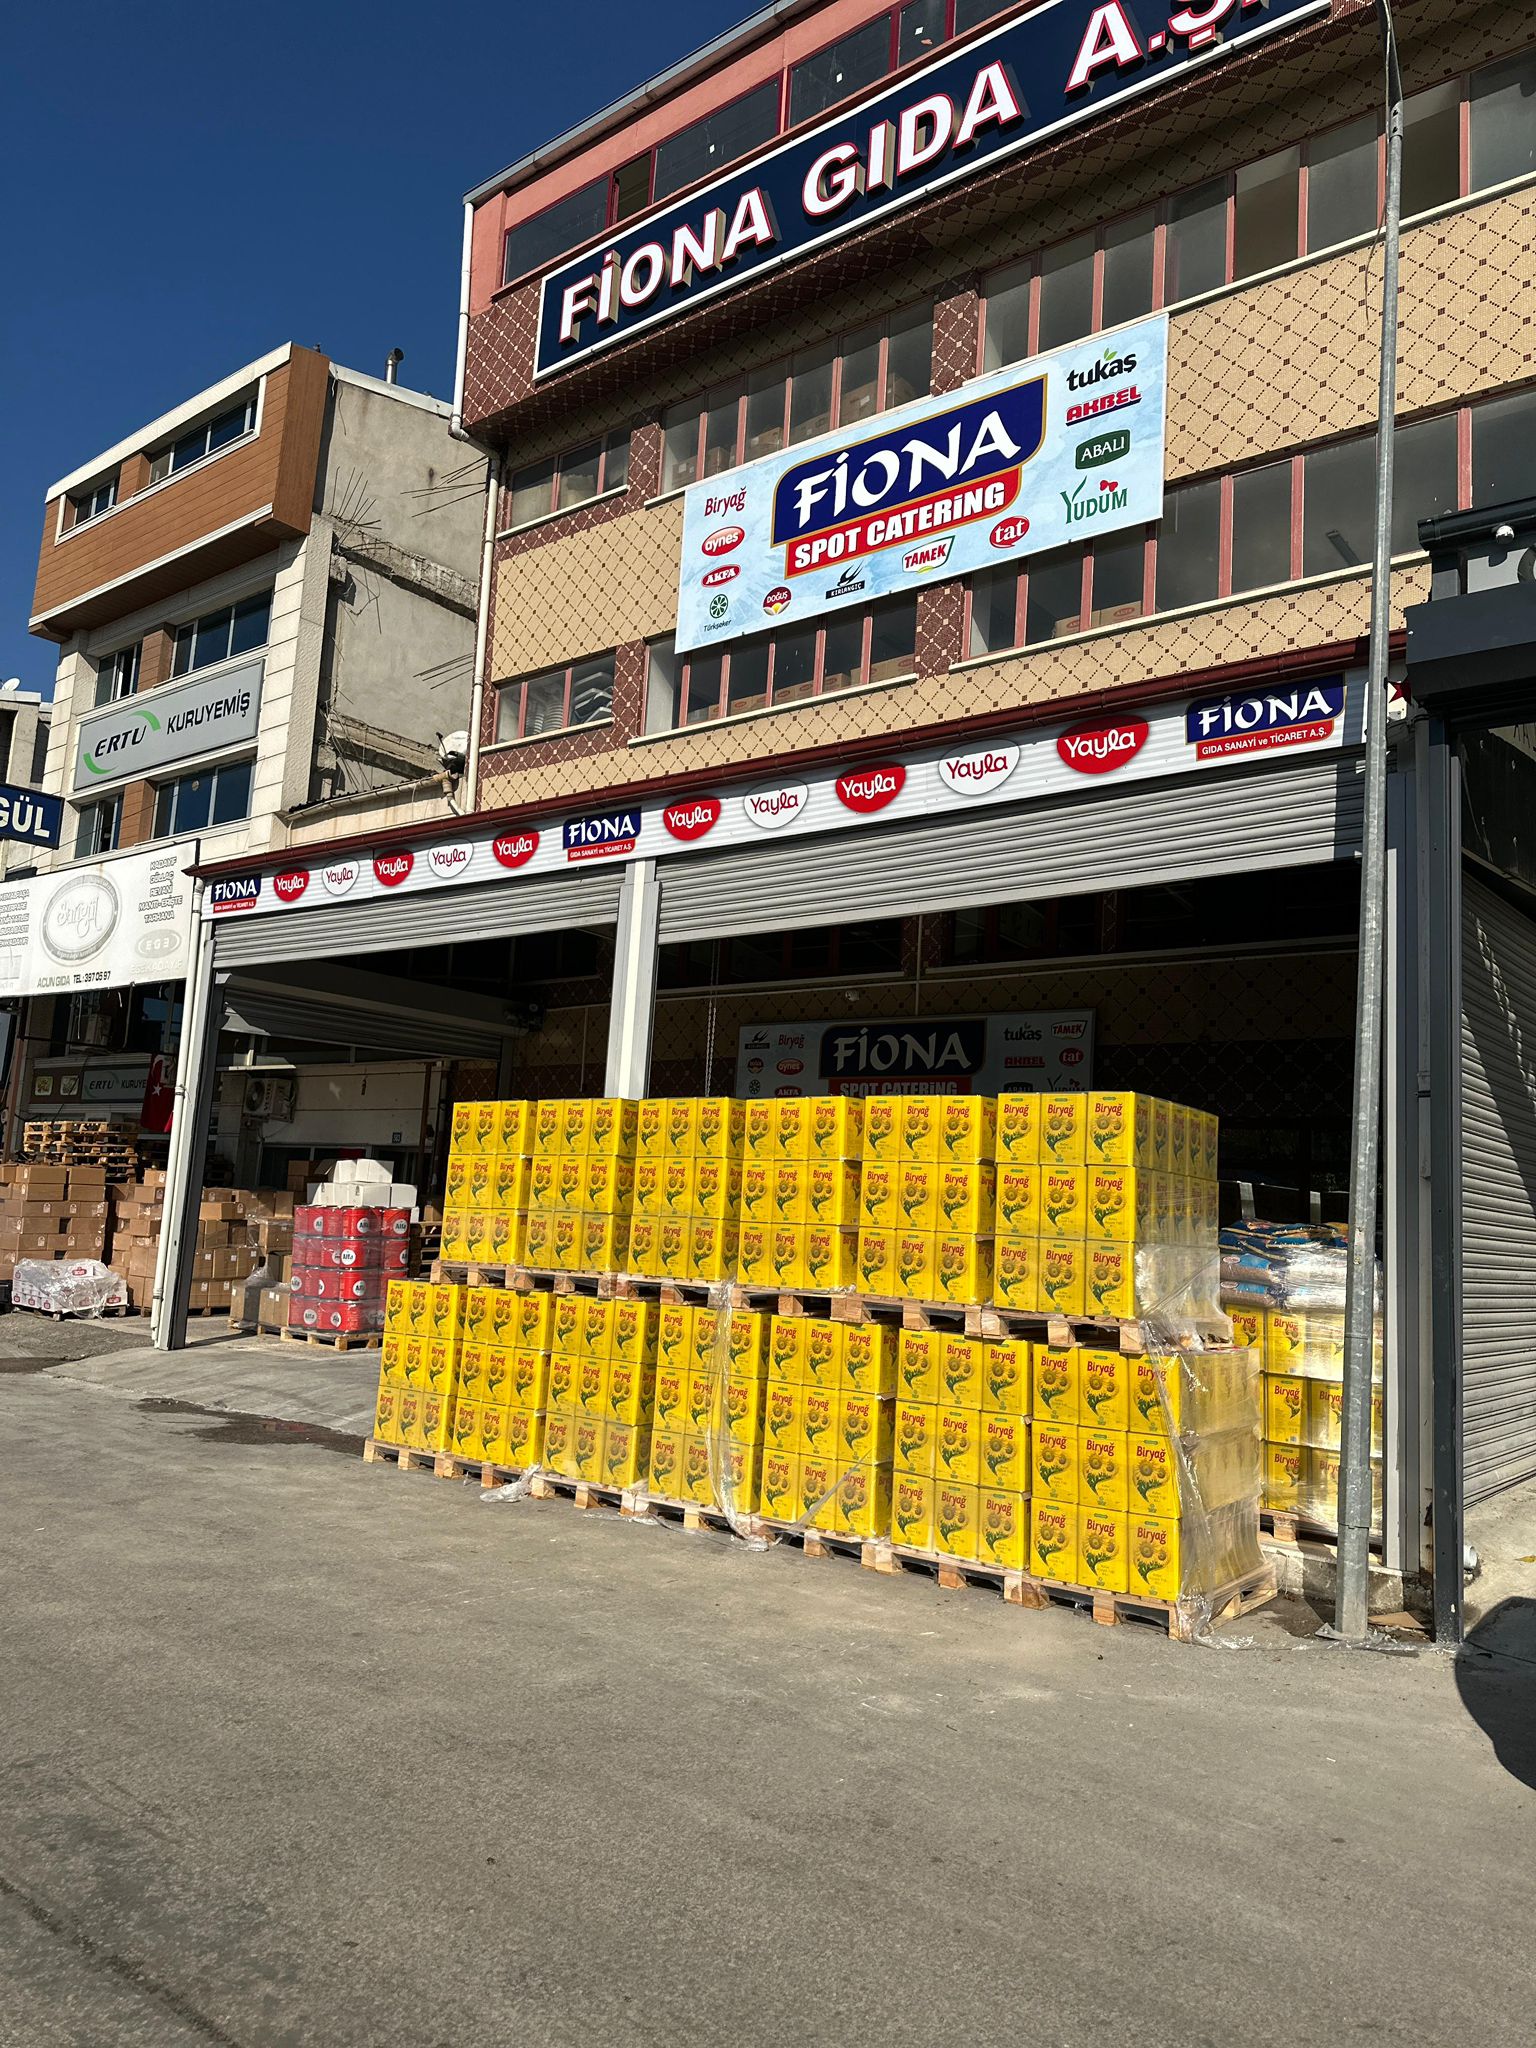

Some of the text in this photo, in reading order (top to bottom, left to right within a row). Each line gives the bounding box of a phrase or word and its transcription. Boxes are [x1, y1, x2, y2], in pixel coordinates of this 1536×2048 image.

[801, 59, 1021, 216] GIDA
[1066, 353, 1137, 391] tukaş
[1066, 385, 1142, 422] AKBEL
[1081, 437, 1125, 462] ABALI
[704, 486, 747, 517] Biryağ
[995, 520, 1025, 543] tat
[705, 533, 739, 552] aynes
[795, 526, 861, 569] SPOT
[904, 544, 947, 569] TAMEK
[705, 566, 737, 585] AKFA
[95, 688, 250, 758] ERTU KURUYEMİŞ
[1065, 729, 1136, 761] Yayla
[1202, 745, 1223, 755] GIDA
[1224, 736, 1257, 751] SANAYİ
[1269, 732, 1308, 744] TİCARET
[1309, 727, 1327, 738] A.Ş.
[946, 754, 1010, 783] Yayla
[840, 773, 897, 799] Yayla
[749, 792, 799, 816] Yayla
[668, 805, 713, 830] Yayla
[496, 837, 534, 858] Yayla
[433, 847, 467, 868] Yayla
[377, 857, 408, 878] Yayla
[277, 876, 304, 893] Yayla
[326, 867, 354, 888] Yayla
[103, 970, 111, 981] 97
[840, 1082, 879, 1098] SPOT
[1004, 1104, 1029, 1116] Biryağ
[1048, 1105, 1074, 1117] Biryağ
[1095, 1103, 1122, 1116] Biryağ
[1004, 1175, 1029, 1187] Biryağ
[1049, 1176, 1075, 1189] Biryağ
[1095, 1177, 1123, 1189] Biryağ
[1001, 1247, 1027, 1260] Biryağ
[1046, 1250, 1072, 1264] Biryağ
[1093, 1252, 1121, 1266] Biryağ
[1232, 1314, 1256, 1329] Biryağ
[1274, 1317, 1298, 1332] Biryağ
[905, 1339, 928, 1354] Biryağ
[947, 1344, 971, 1360] Biryağ
[990, 1350, 1015, 1364] Biryağ
[1041, 1356, 1067, 1371] Biryağ
[1087, 1360, 1115, 1378] Biryağ
[1275, 1385, 1300, 1401] Biryağ
[902, 1411, 925, 1426] Biryağ
[942, 1417, 967, 1432] Biryağ
[988, 1423, 1014, 1439] Biryağ
[1040, 1432, 1066, 1449] Biryağ
[1086, 1440, 1114, 1456] Biryağ
[1137, 1446, 1165, 1462] Biryağ
[1274, 1453, 1300, 1469] Biryağ
[899, 1484, 923, 1500] Biryağ
[942, 1490, 966, 1508] Biryağ
[986, 1499, 1012, 1515] Biryağ
[1039, 1510, 1065, 1528] Biryağ
[1087, 1519, 1115, 1536] Biryağ
[1137, 1527, 1166, 1544] Biryağ
